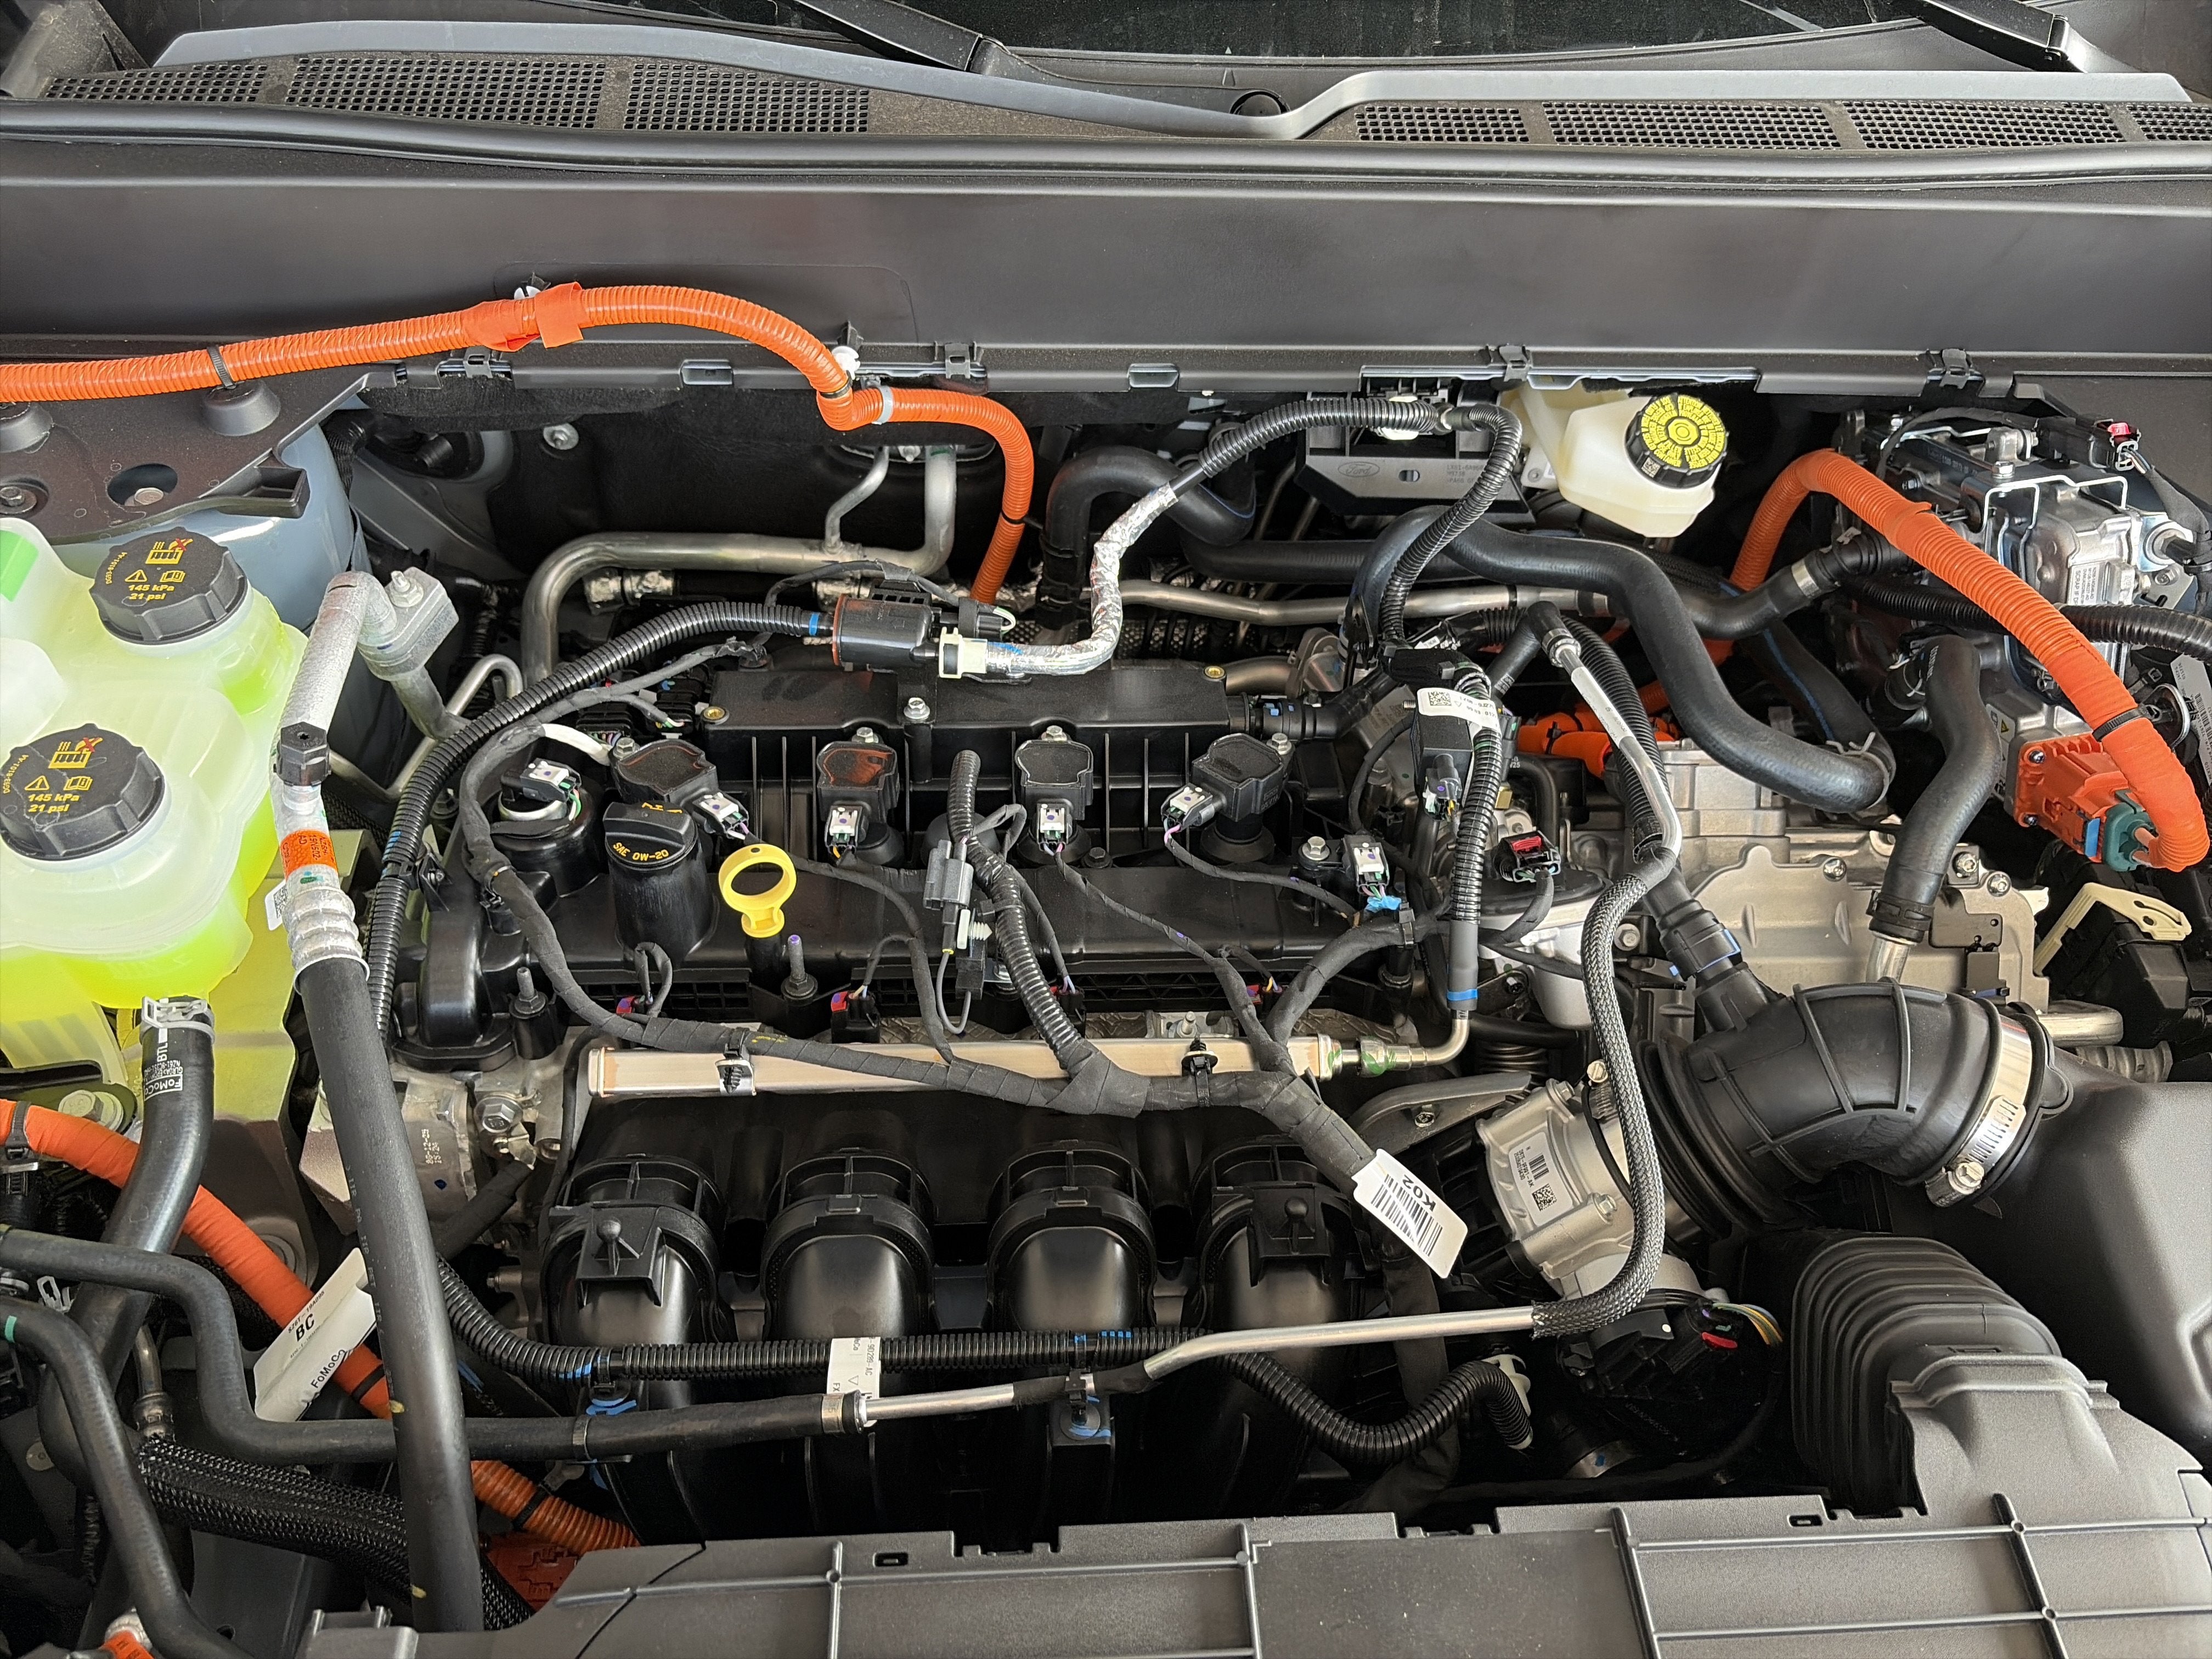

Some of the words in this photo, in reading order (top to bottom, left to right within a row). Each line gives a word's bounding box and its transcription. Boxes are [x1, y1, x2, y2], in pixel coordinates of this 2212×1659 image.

[146, 593, 166, 601] psi
[3, 754, 29, 794] DG93-8101-AA
[48, 804, 70, 814] psi
[613, 842, 631, 857] SAE
[632, 849, 669, 861] 0W-20
[145, 1077, 182, 1096] FoMoCo
[1402, 1173, 1436, 1213] K02
[296, 1313, 315, 1342] BC
[311, 1348, 346, 1389] FoMoCo
[833, 1382, 840, 1392] FX
